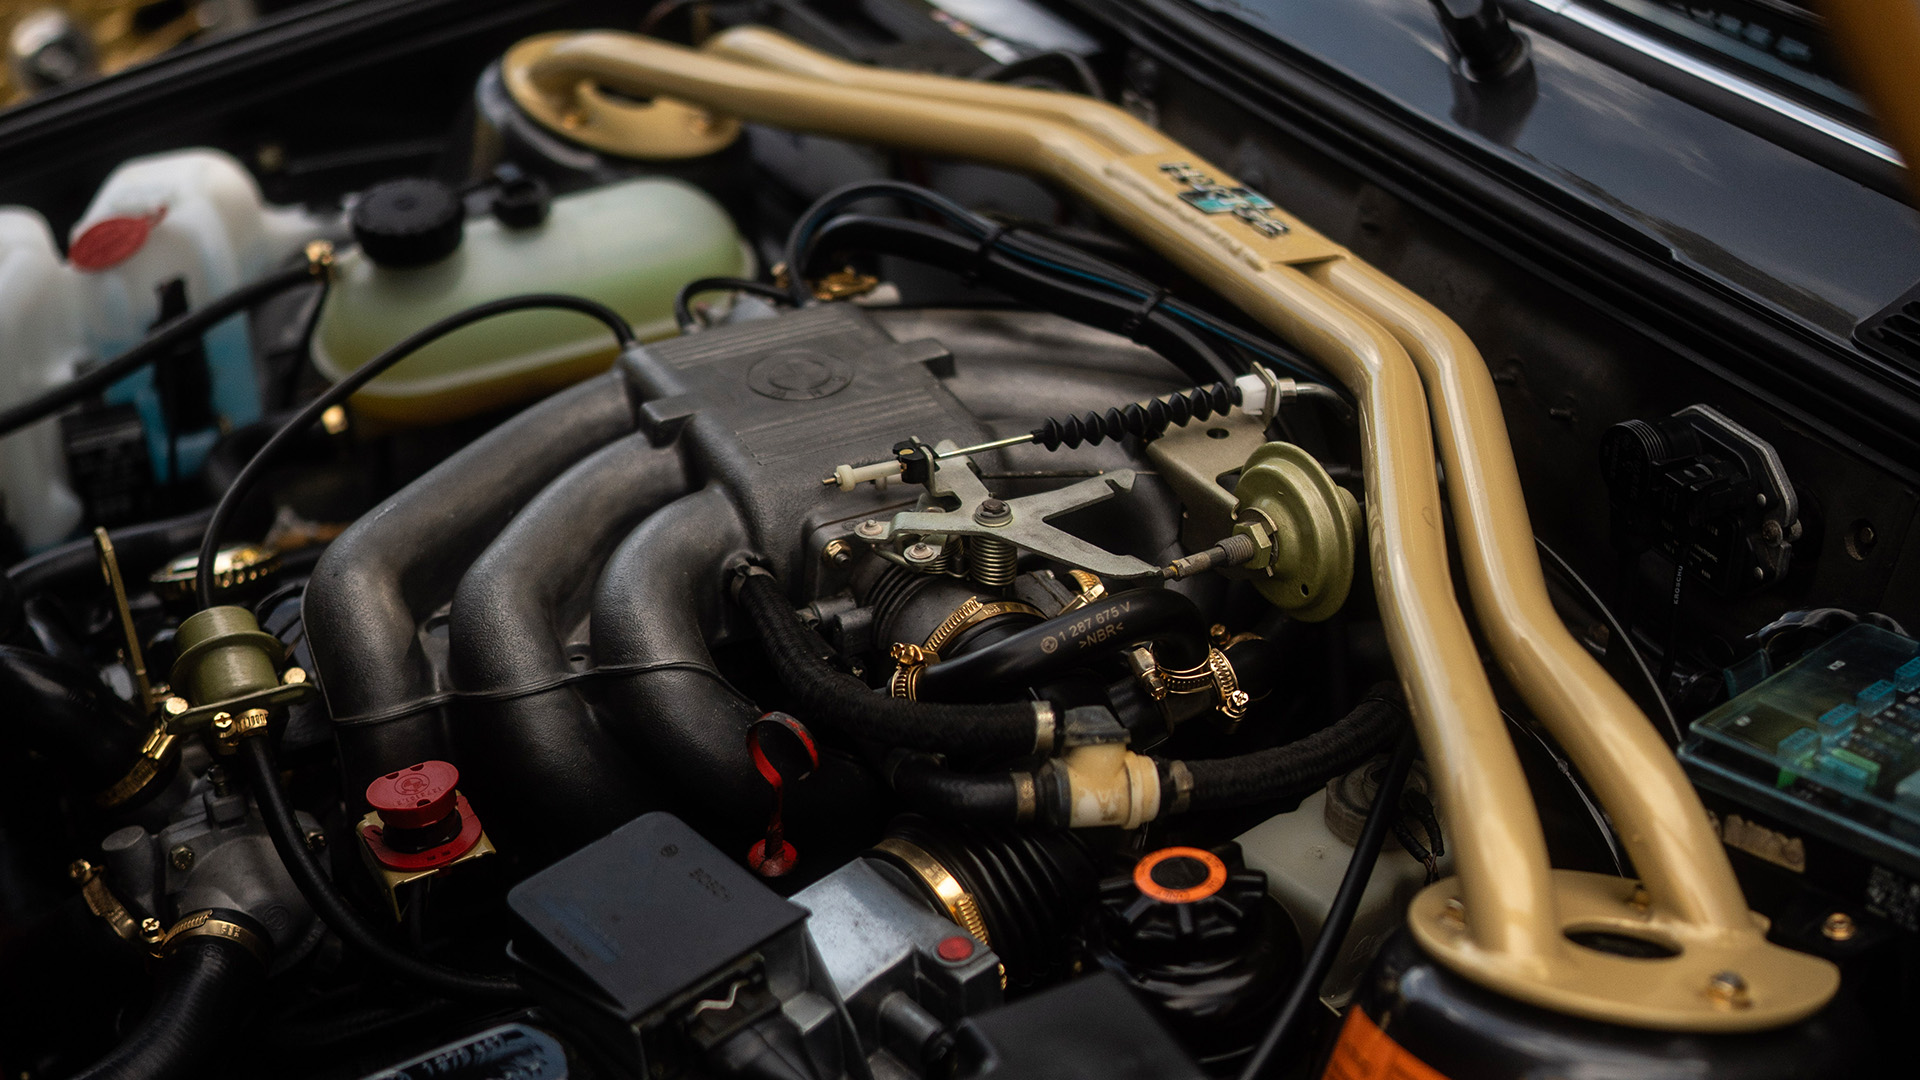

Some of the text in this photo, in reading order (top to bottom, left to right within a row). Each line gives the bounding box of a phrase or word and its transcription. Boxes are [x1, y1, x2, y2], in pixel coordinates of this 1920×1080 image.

[1059, 601, 1130, 641] 1 287 675 V
